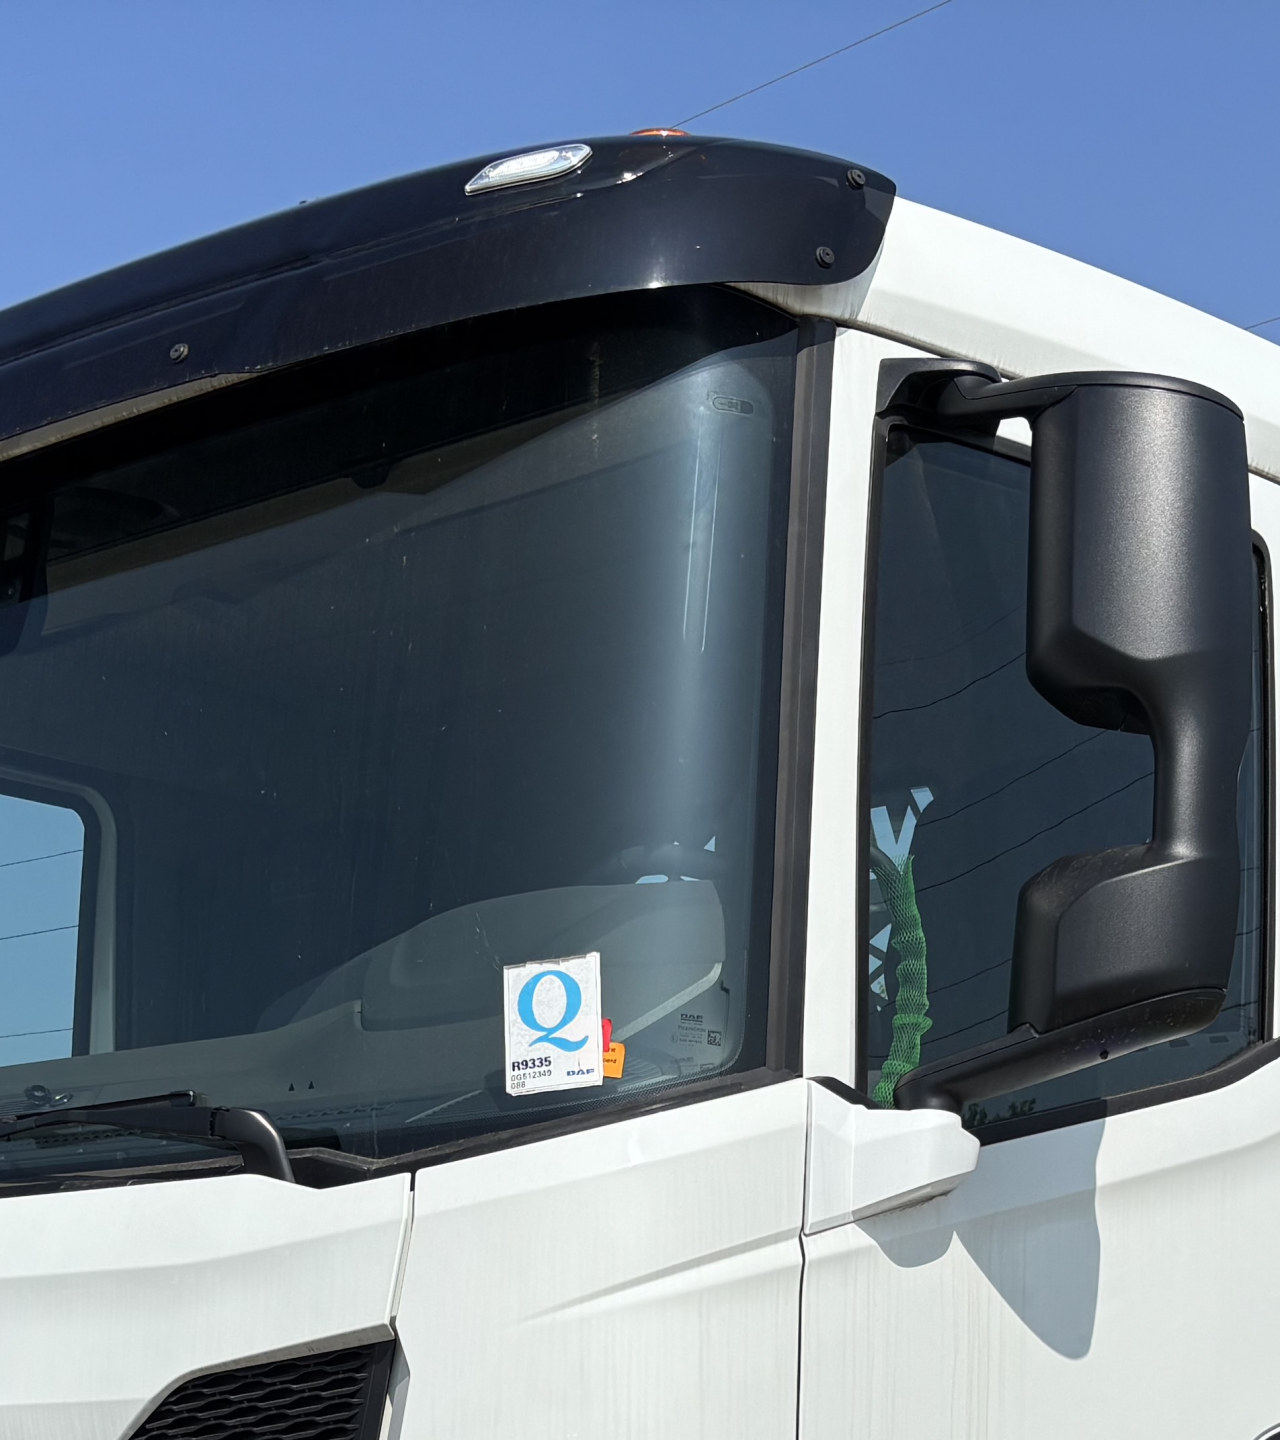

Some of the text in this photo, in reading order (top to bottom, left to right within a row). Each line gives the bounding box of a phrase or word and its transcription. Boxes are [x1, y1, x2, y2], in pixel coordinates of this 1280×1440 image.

[517, 969, 589, 1053] Q
[511, 1056, 552, 1072] R9335
[566, 1068, 595, 1077] DAF
